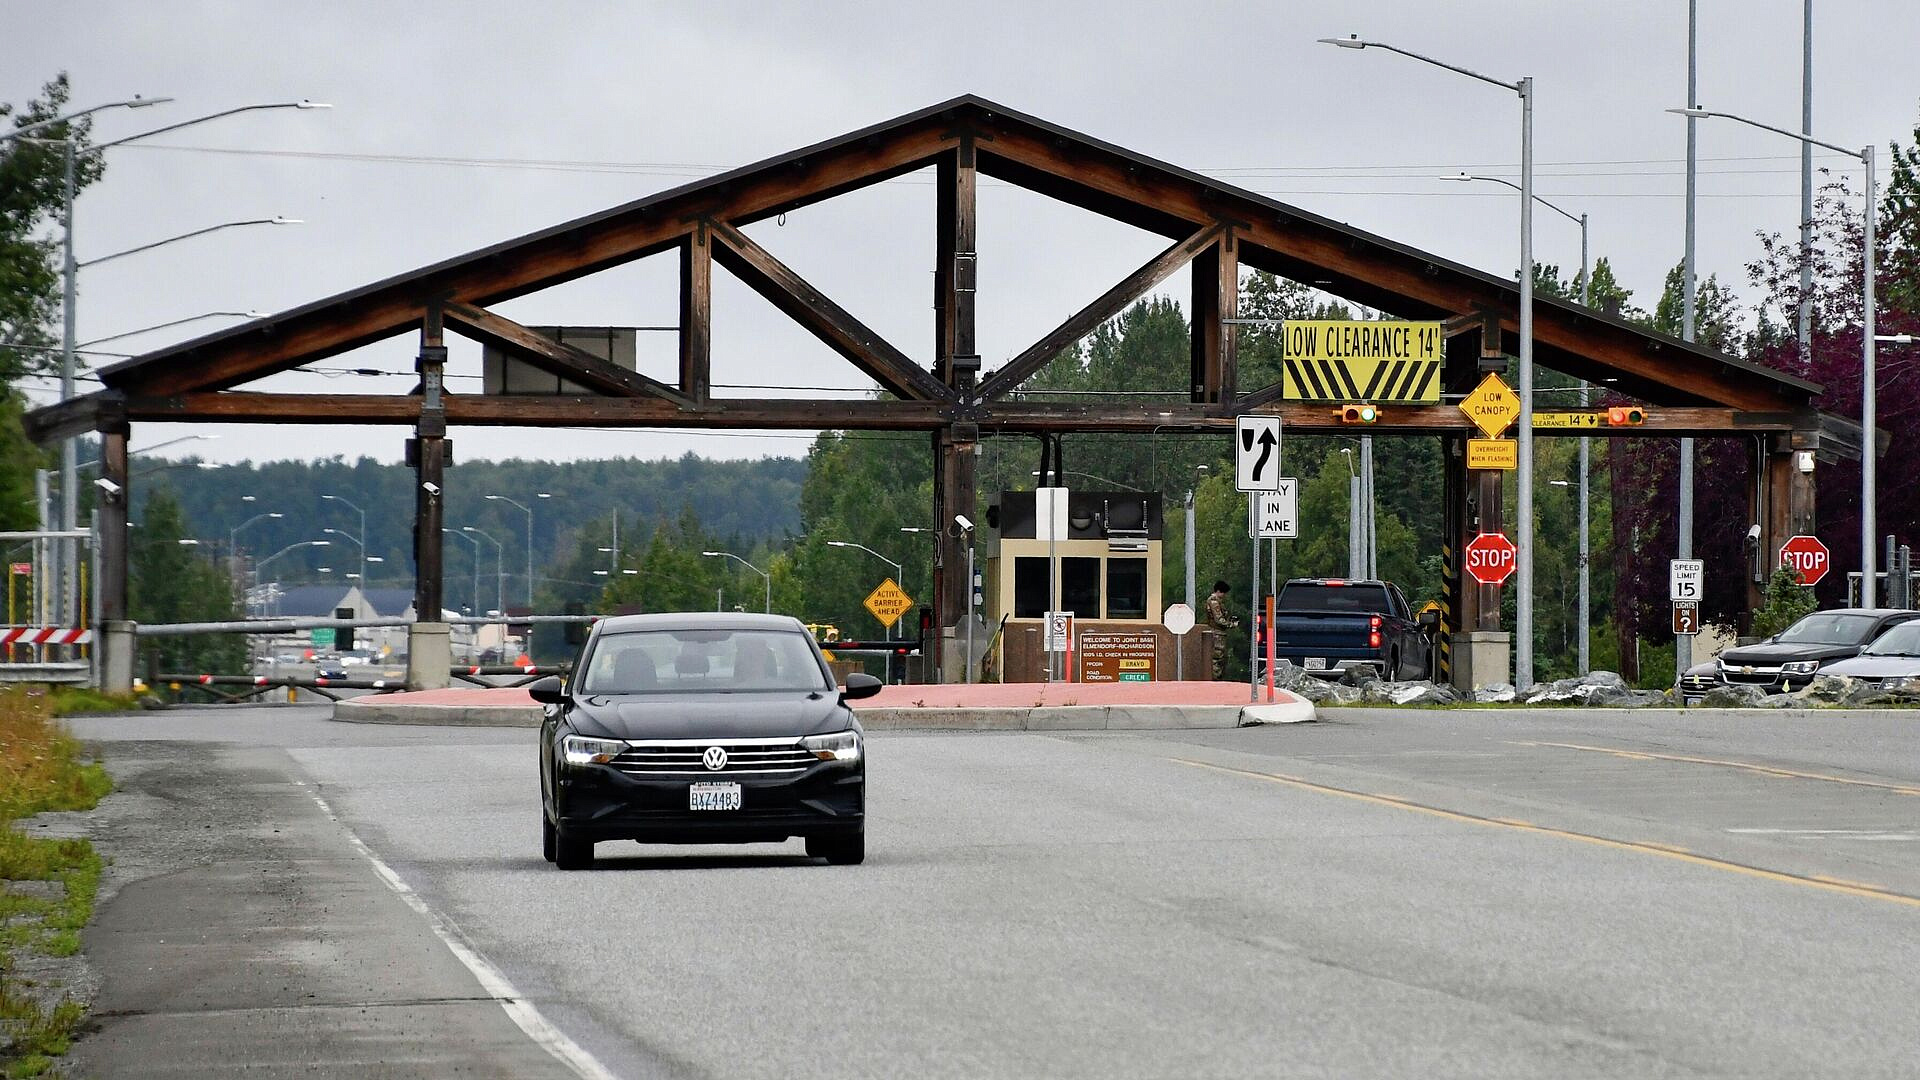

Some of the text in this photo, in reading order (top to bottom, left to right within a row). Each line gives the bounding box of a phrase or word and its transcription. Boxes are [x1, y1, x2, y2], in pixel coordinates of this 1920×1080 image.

[1285, 326, 1438, 358] LOW CLEARANCE 14'
[1484, 392, 1502, 402] LOW
[1474, 405, 1511, 415] CANOPY
[1267, 502, 1279, 514] IN
[1259, 520, 1290, 531] ANE
[1470, 549, 1512, 567] STOP
[1677, 582, 1695, 597] 15
[1680, 616, 1691, 632] ?
